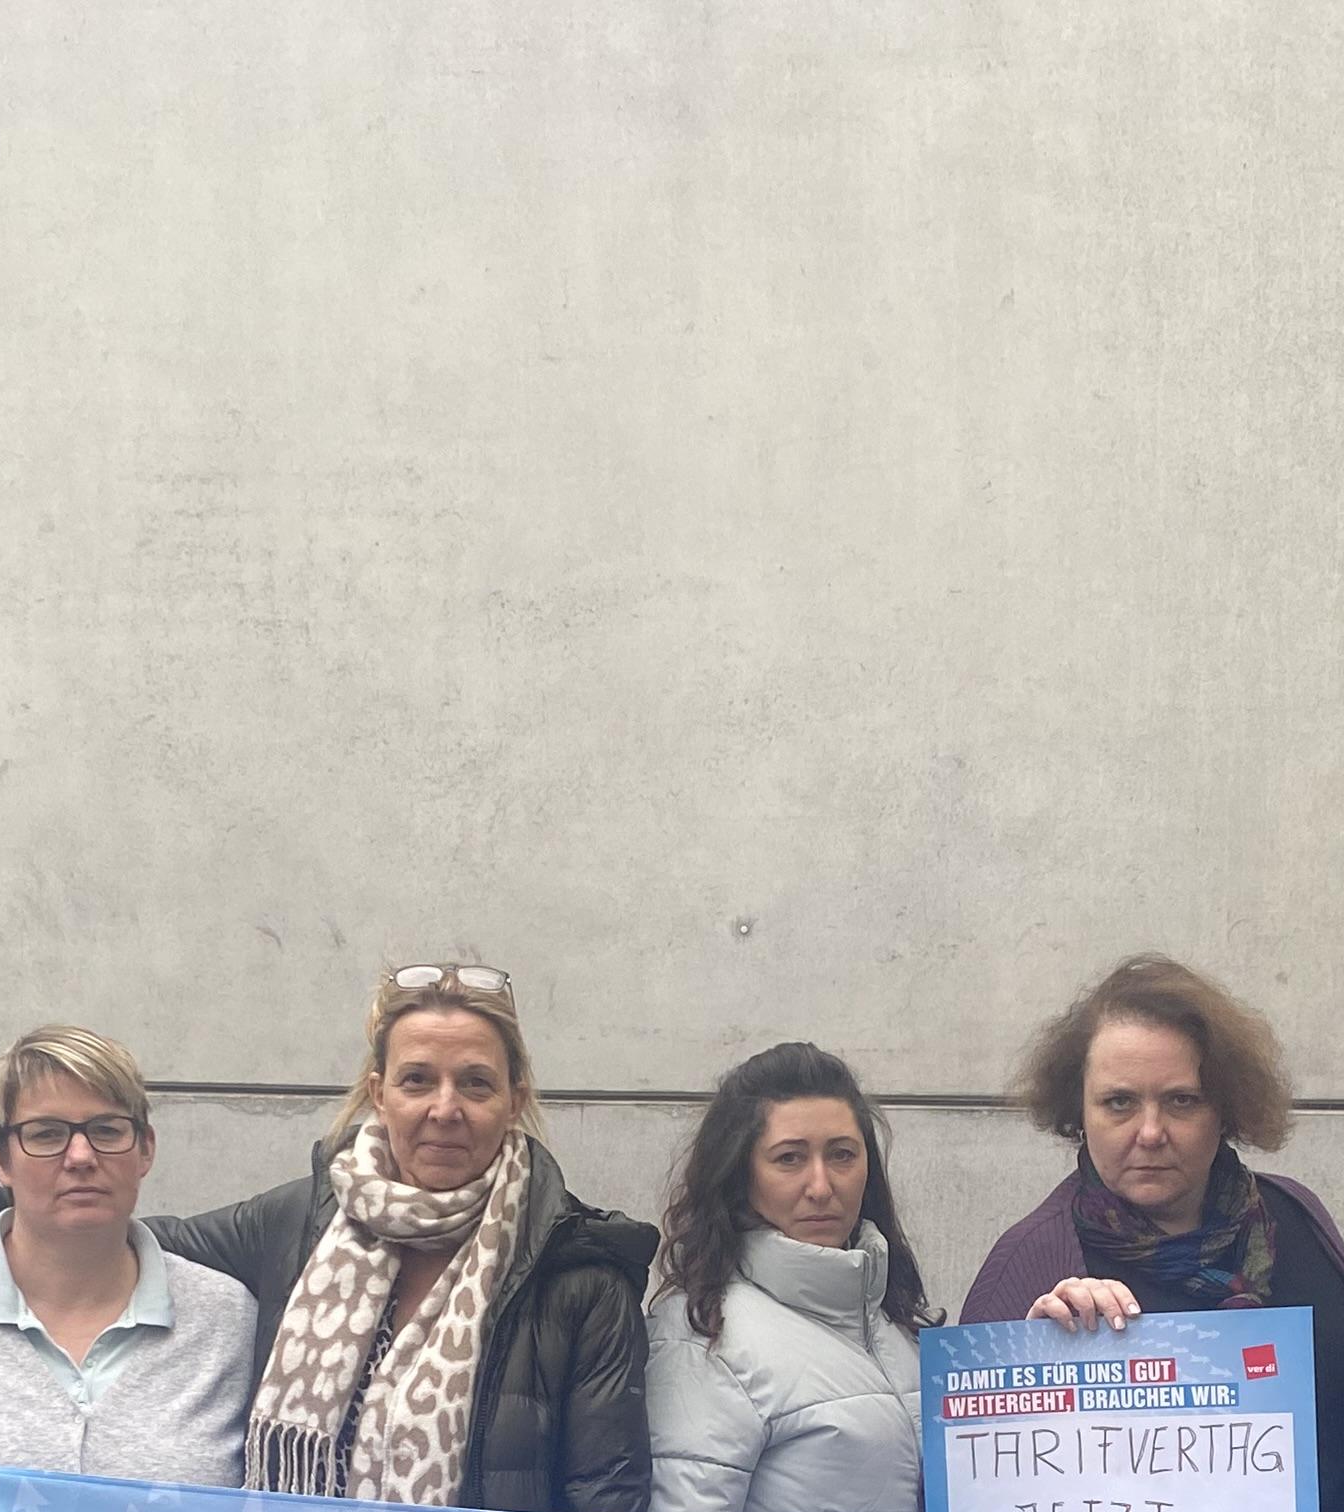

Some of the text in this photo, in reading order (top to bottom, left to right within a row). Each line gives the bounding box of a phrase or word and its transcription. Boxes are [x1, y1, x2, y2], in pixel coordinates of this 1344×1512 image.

[947, 1360, 1172, 1392] DAMIT ES FÜR UNS GUT
[948, 1386, 1236, 1417] WEITERGEHT, BRAUCHEN WIR:
[955, 1422, 1286, 1480] TARIFVERTAG
